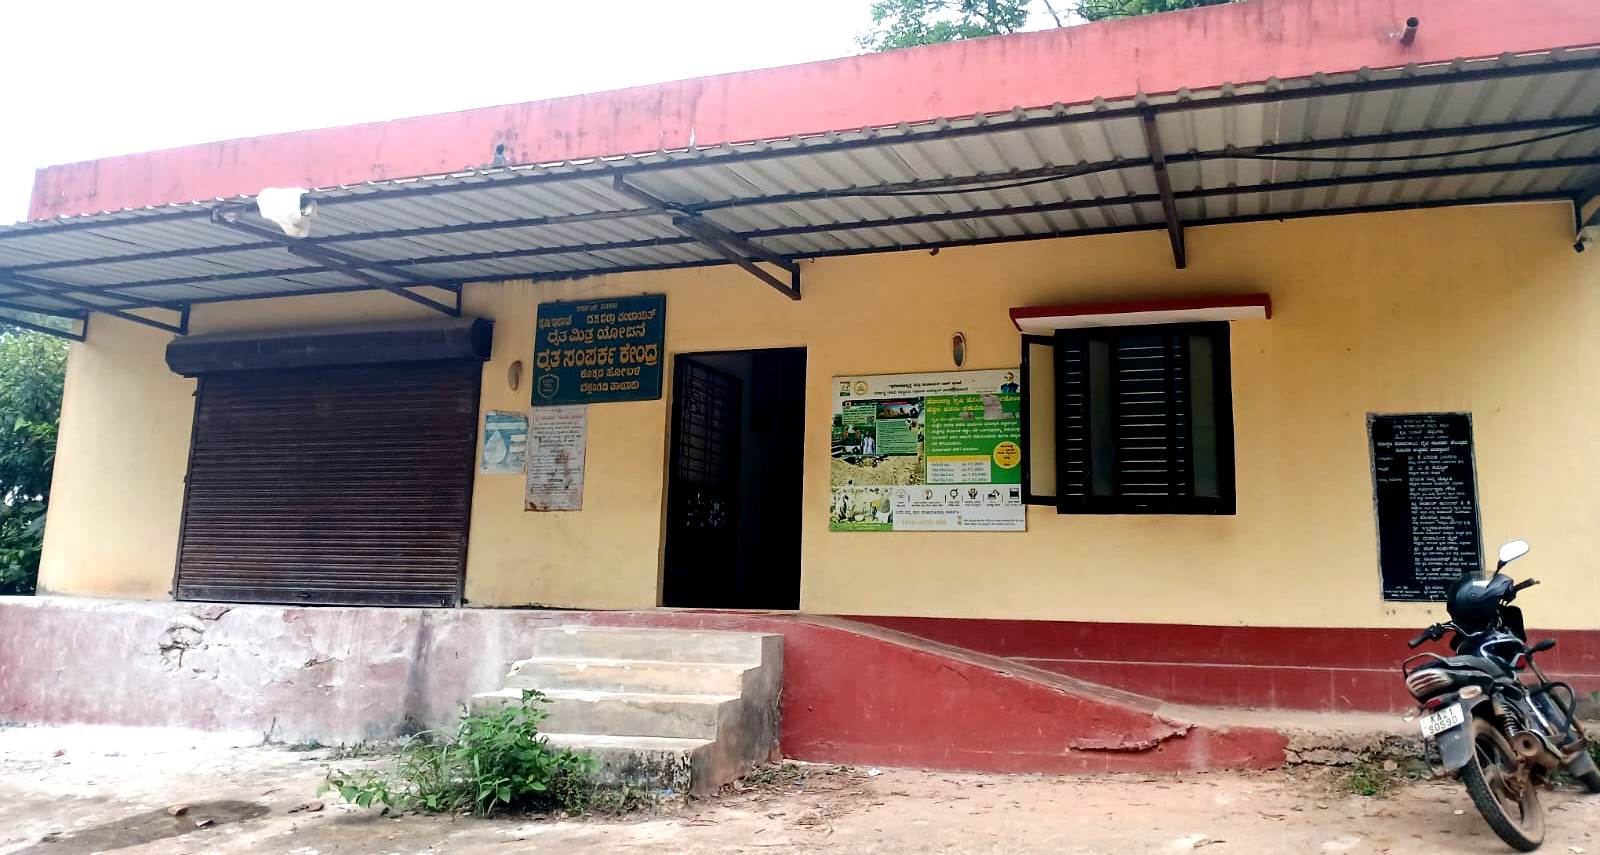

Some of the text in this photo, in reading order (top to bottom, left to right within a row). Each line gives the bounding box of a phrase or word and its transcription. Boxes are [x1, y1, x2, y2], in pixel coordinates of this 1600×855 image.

[548, 322, 646, 346] ರೈತ ಮಿತ್ರ ಯೋಜನೆ
[536, 343, 658, 372] ರೈತ ಸಂಪರ್ಕ ಕೇಂದ್ರ
[1430, 708, 1453, 724] KA21
